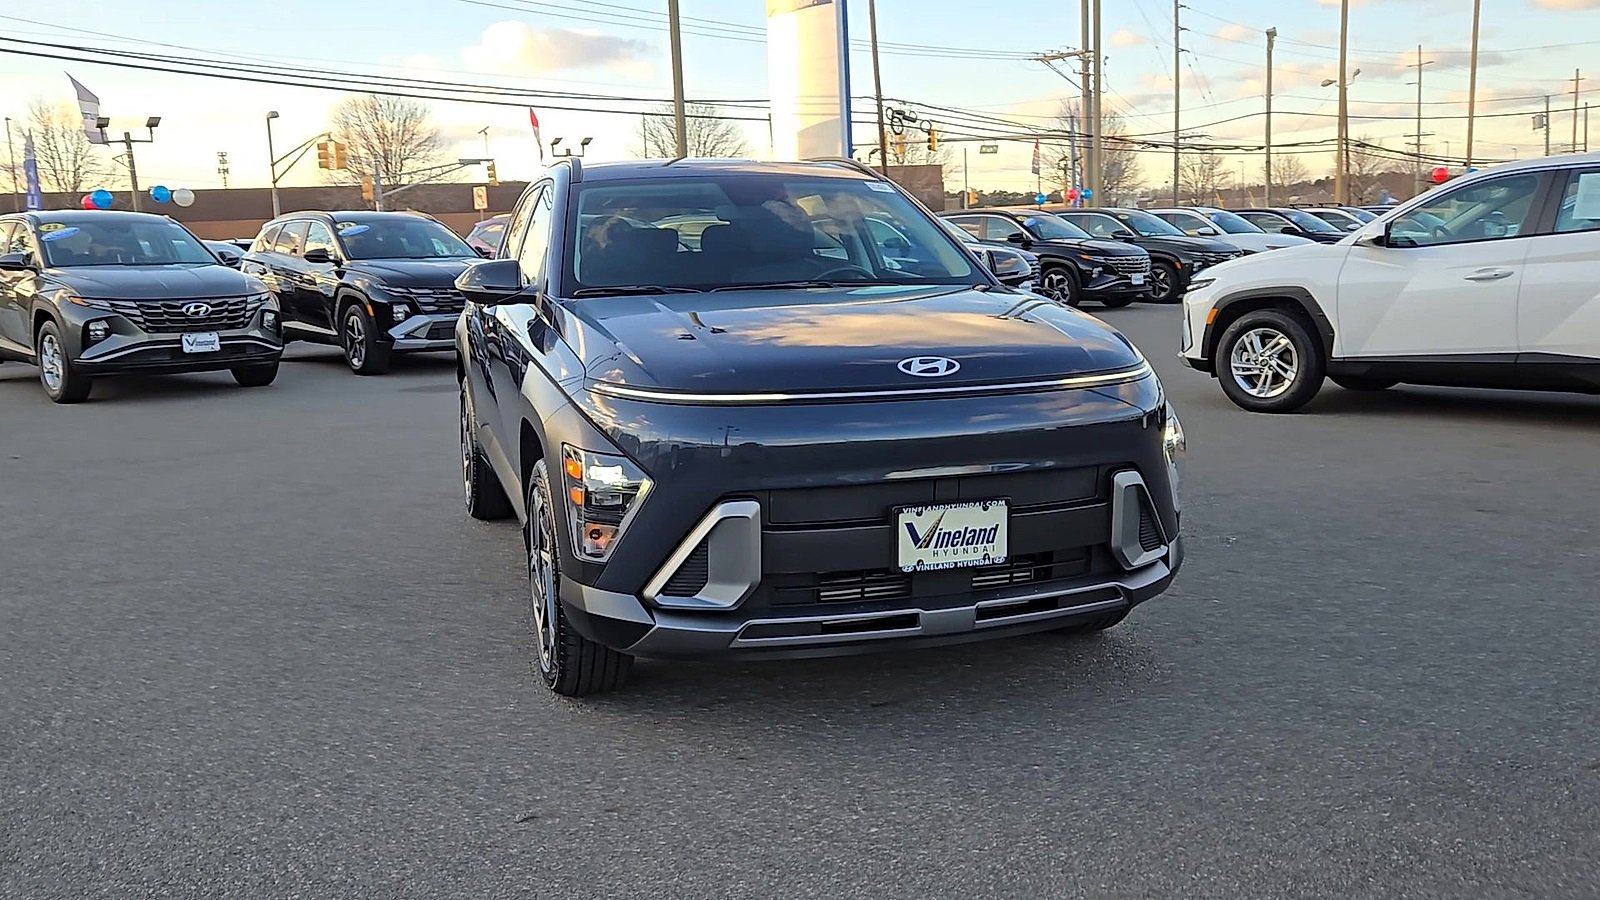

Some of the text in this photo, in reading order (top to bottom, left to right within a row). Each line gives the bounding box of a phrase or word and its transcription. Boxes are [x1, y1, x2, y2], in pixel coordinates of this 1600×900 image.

[904, 509, 1000, 550] Vineland
[933, 545, 995, 557] HYUNDAI
[915, 558, 993, 572] VINELAND HYUNDAI
